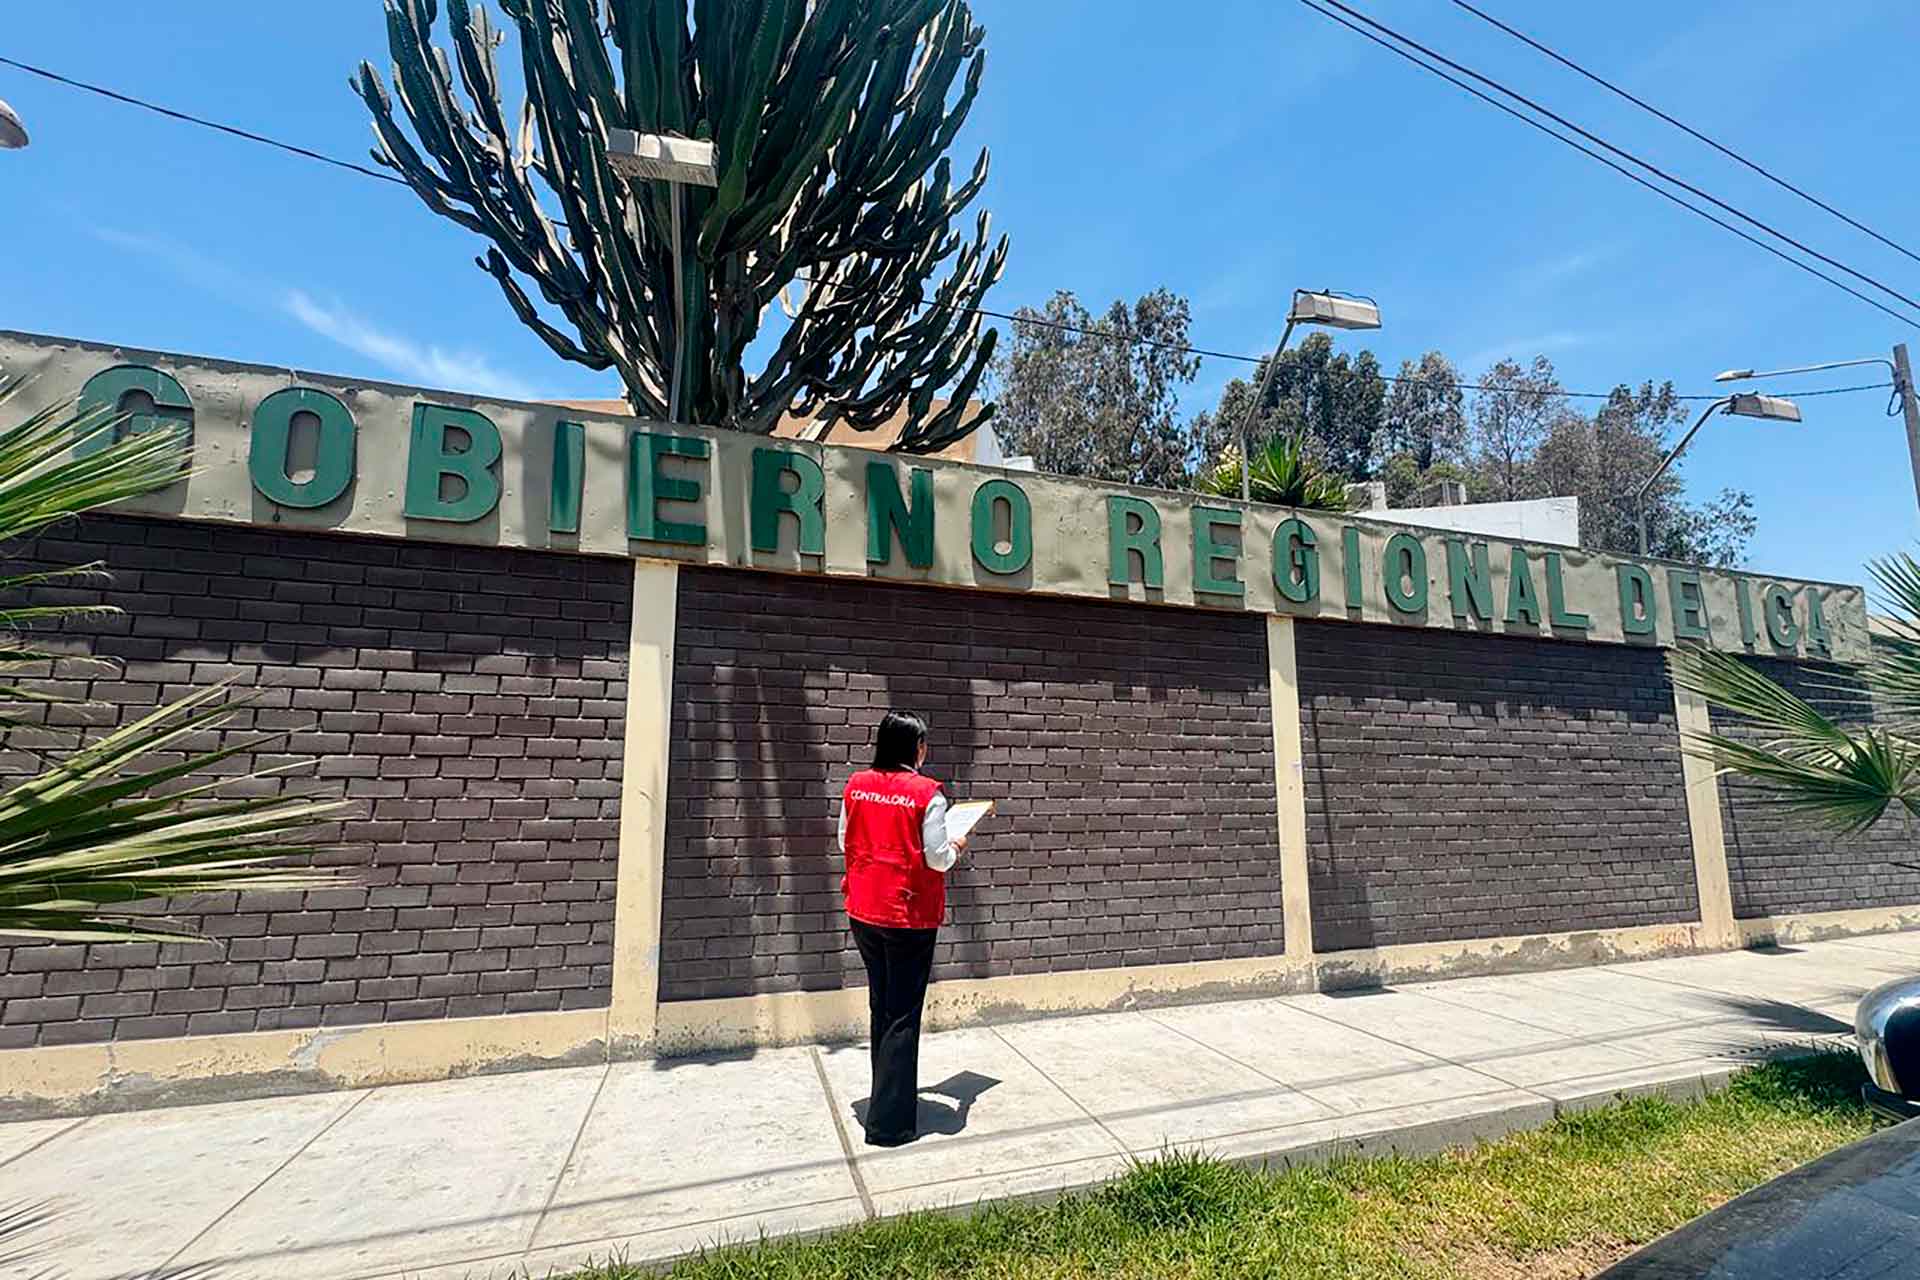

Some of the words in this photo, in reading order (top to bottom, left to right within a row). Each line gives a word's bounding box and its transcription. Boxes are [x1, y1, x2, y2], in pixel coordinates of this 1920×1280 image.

[73, 364, 1032, 574] GOBIERNO
[1108, 495, 1589, 630] REGIONAL
[1617, 562, 1709, 639] DE
[1736, 578, 1832, 660] ICA
